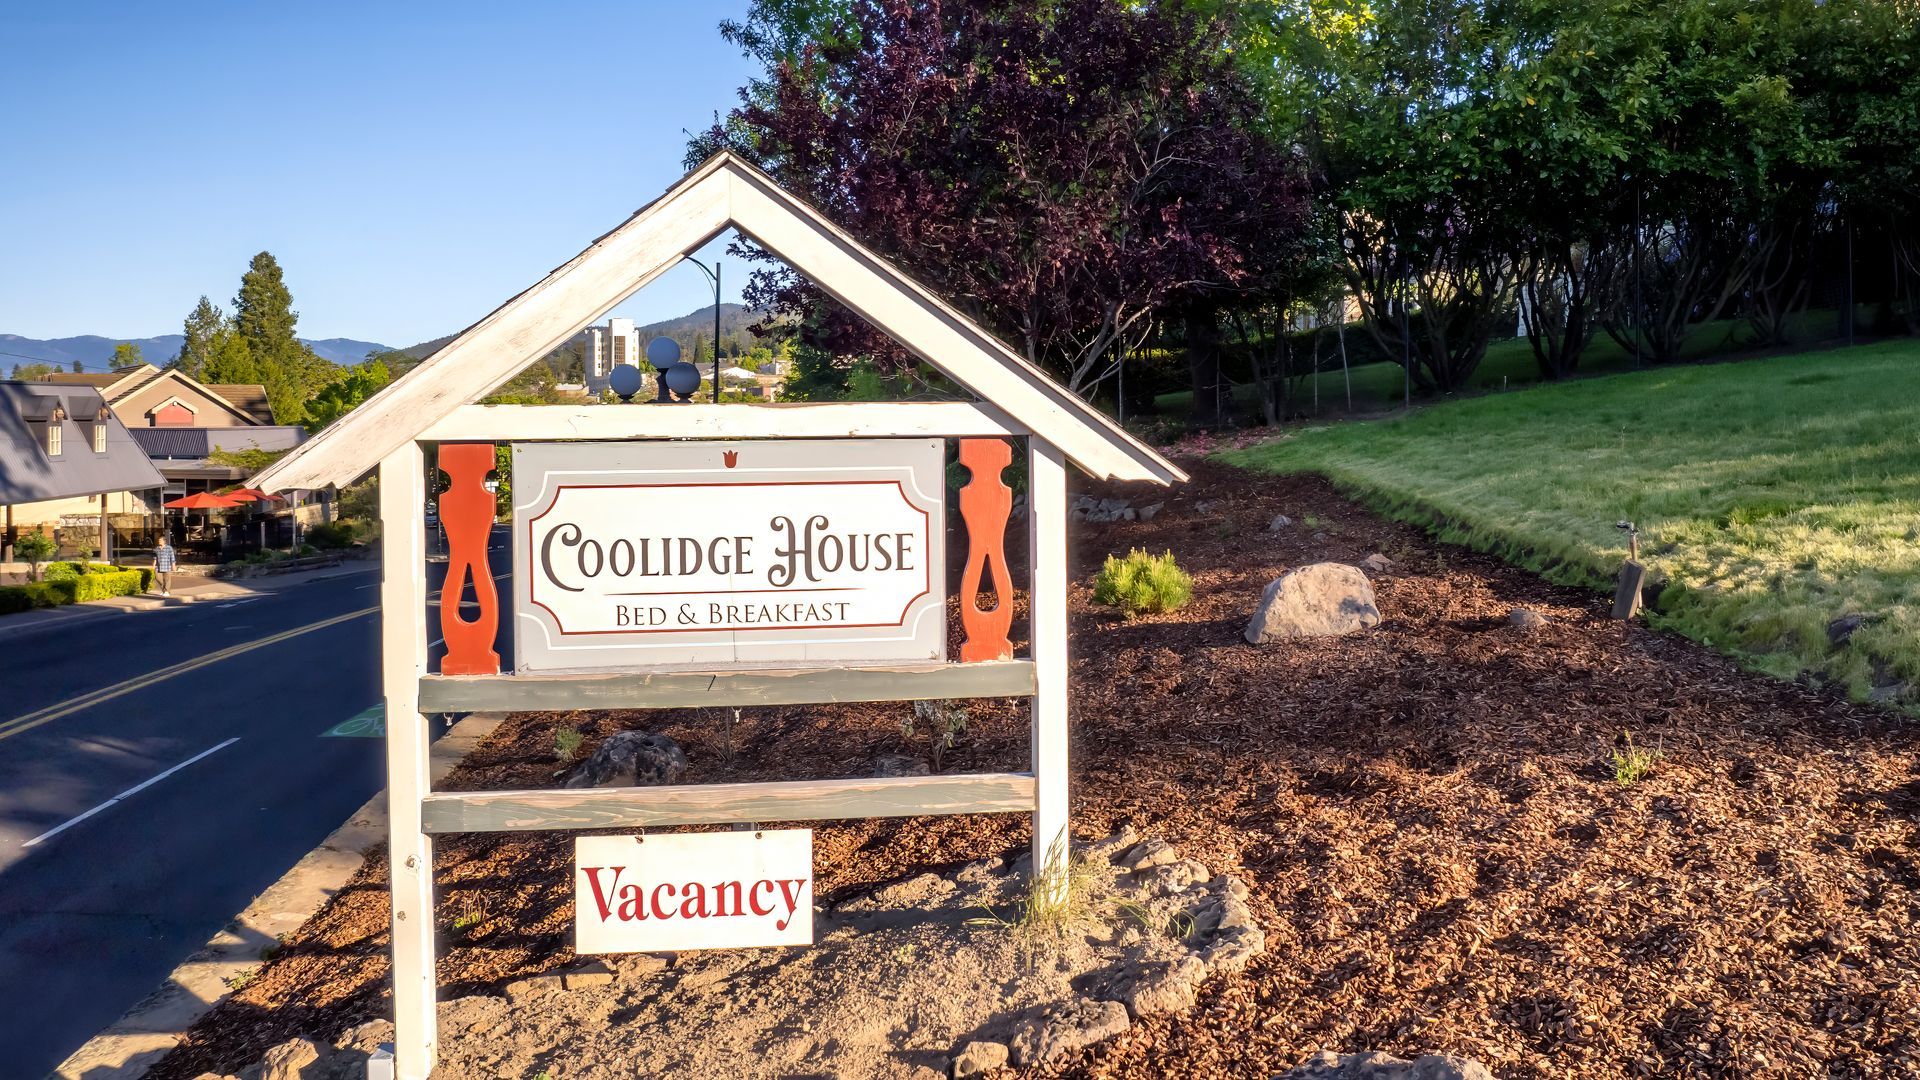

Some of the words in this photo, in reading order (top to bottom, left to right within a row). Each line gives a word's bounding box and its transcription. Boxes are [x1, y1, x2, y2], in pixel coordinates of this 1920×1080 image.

[540, 522, 754, 592] COOLIDGE
[767, 514, 915, 588] HOUSE
[616, 604, 667, 627] BED
[677, 603, 700, 625] &
[709, 602, 851, 624] BREAKFAST
[580, 866, 807, 932] Vacancy
